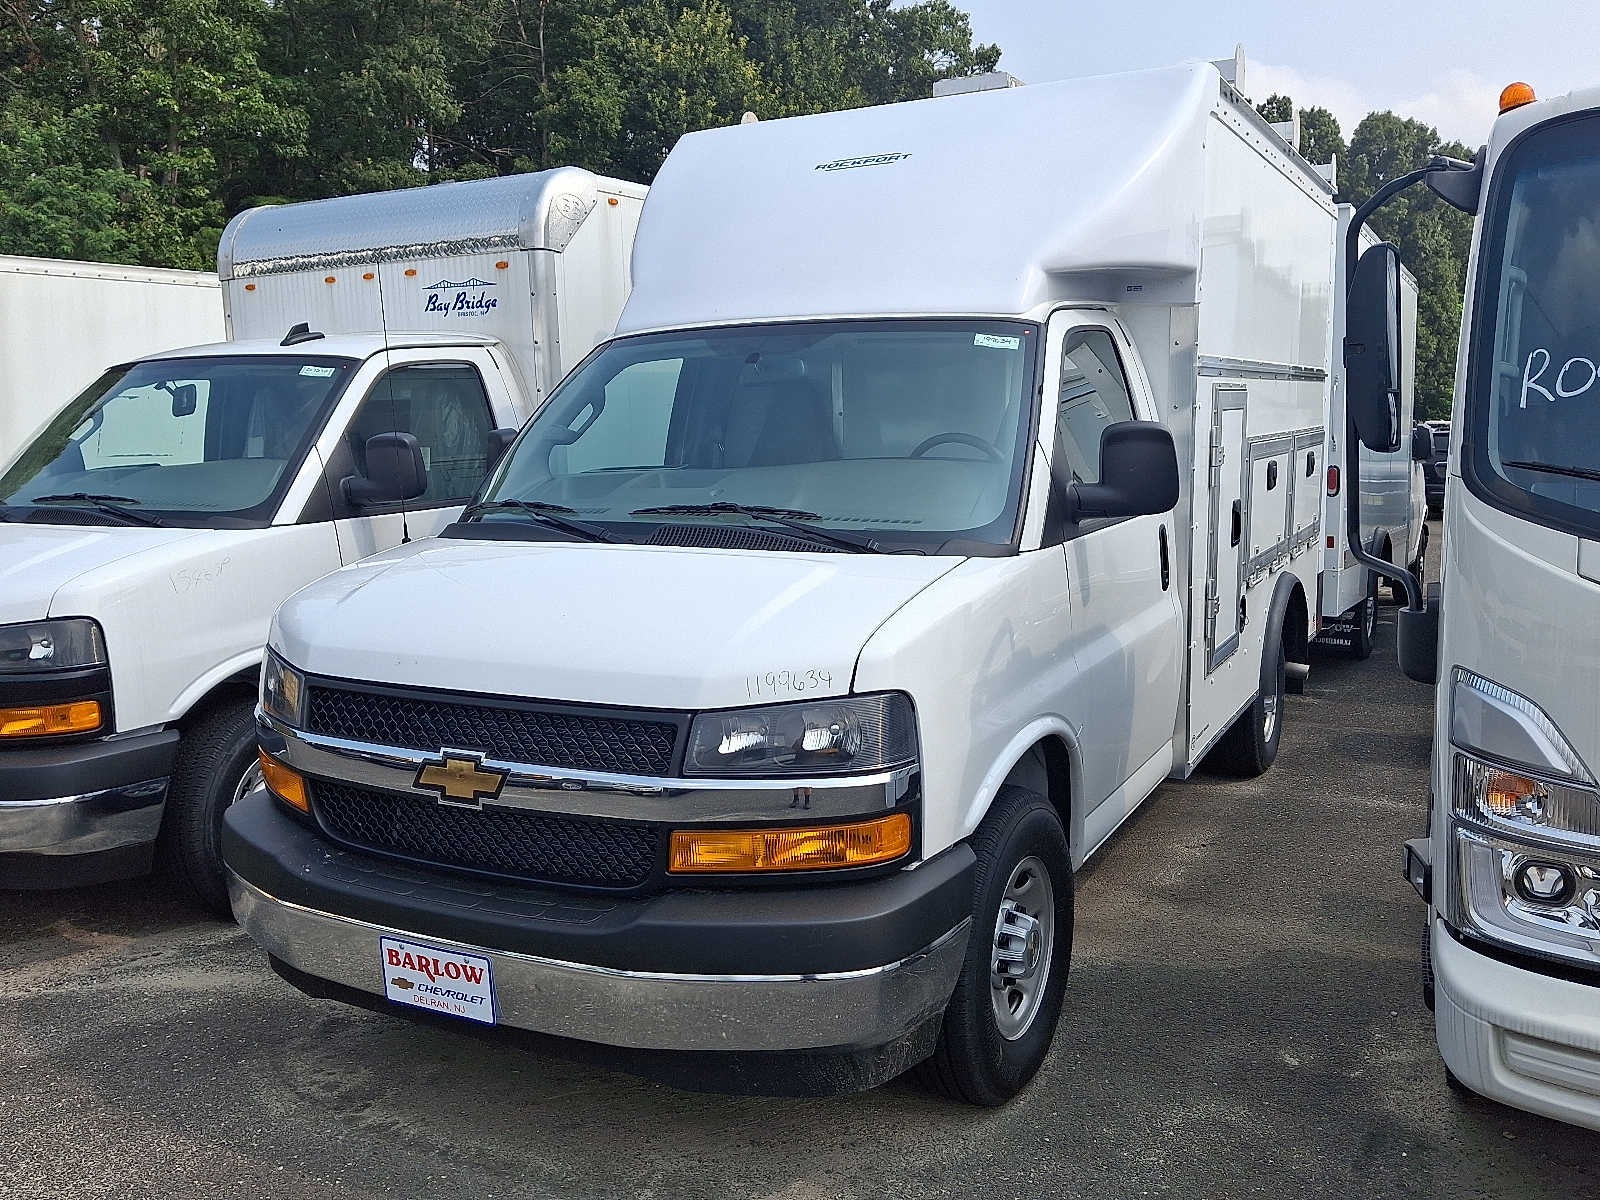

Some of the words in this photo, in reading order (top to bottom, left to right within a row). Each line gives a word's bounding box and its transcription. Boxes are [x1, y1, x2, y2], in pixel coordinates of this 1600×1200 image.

[814, 153, 912, 170] ROCKPORT
[424, 293, 451, 317] Bay
[452, 291, 498, 314] Bridge
[1519, 348, 1600, 409] RO
[746, 669, 832, 698] 1199634
[386, 948, 484, 985] BARLOW
[413, 994, 453, 1012] DELRAN,
[454, 1003, 466, 1014] NJ
[417, 983, 487, 1006] CHEVROLET
